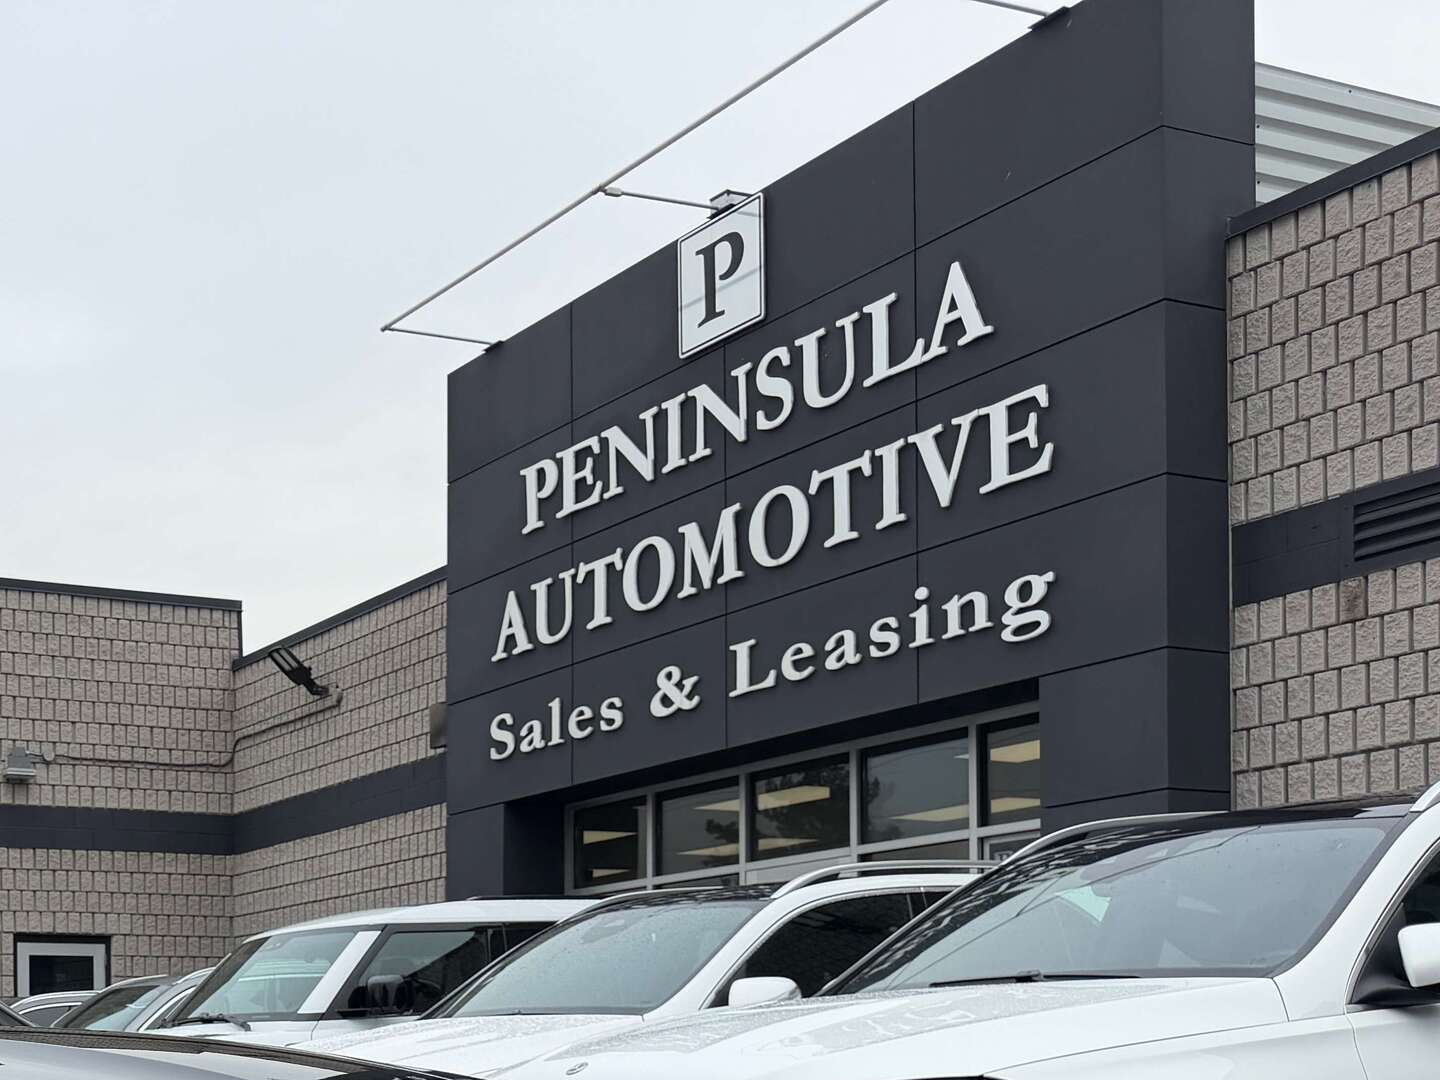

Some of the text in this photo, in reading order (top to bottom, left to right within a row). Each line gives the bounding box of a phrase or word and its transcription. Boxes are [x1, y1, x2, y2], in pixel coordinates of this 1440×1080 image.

[696, 230, 745, 329] P
[519, 260, 994, 535] PENINSULA
[491, 383, 1055, 663] AUTOMOTIVE
[488, 571, 1056, 761] Sales & Leasing
